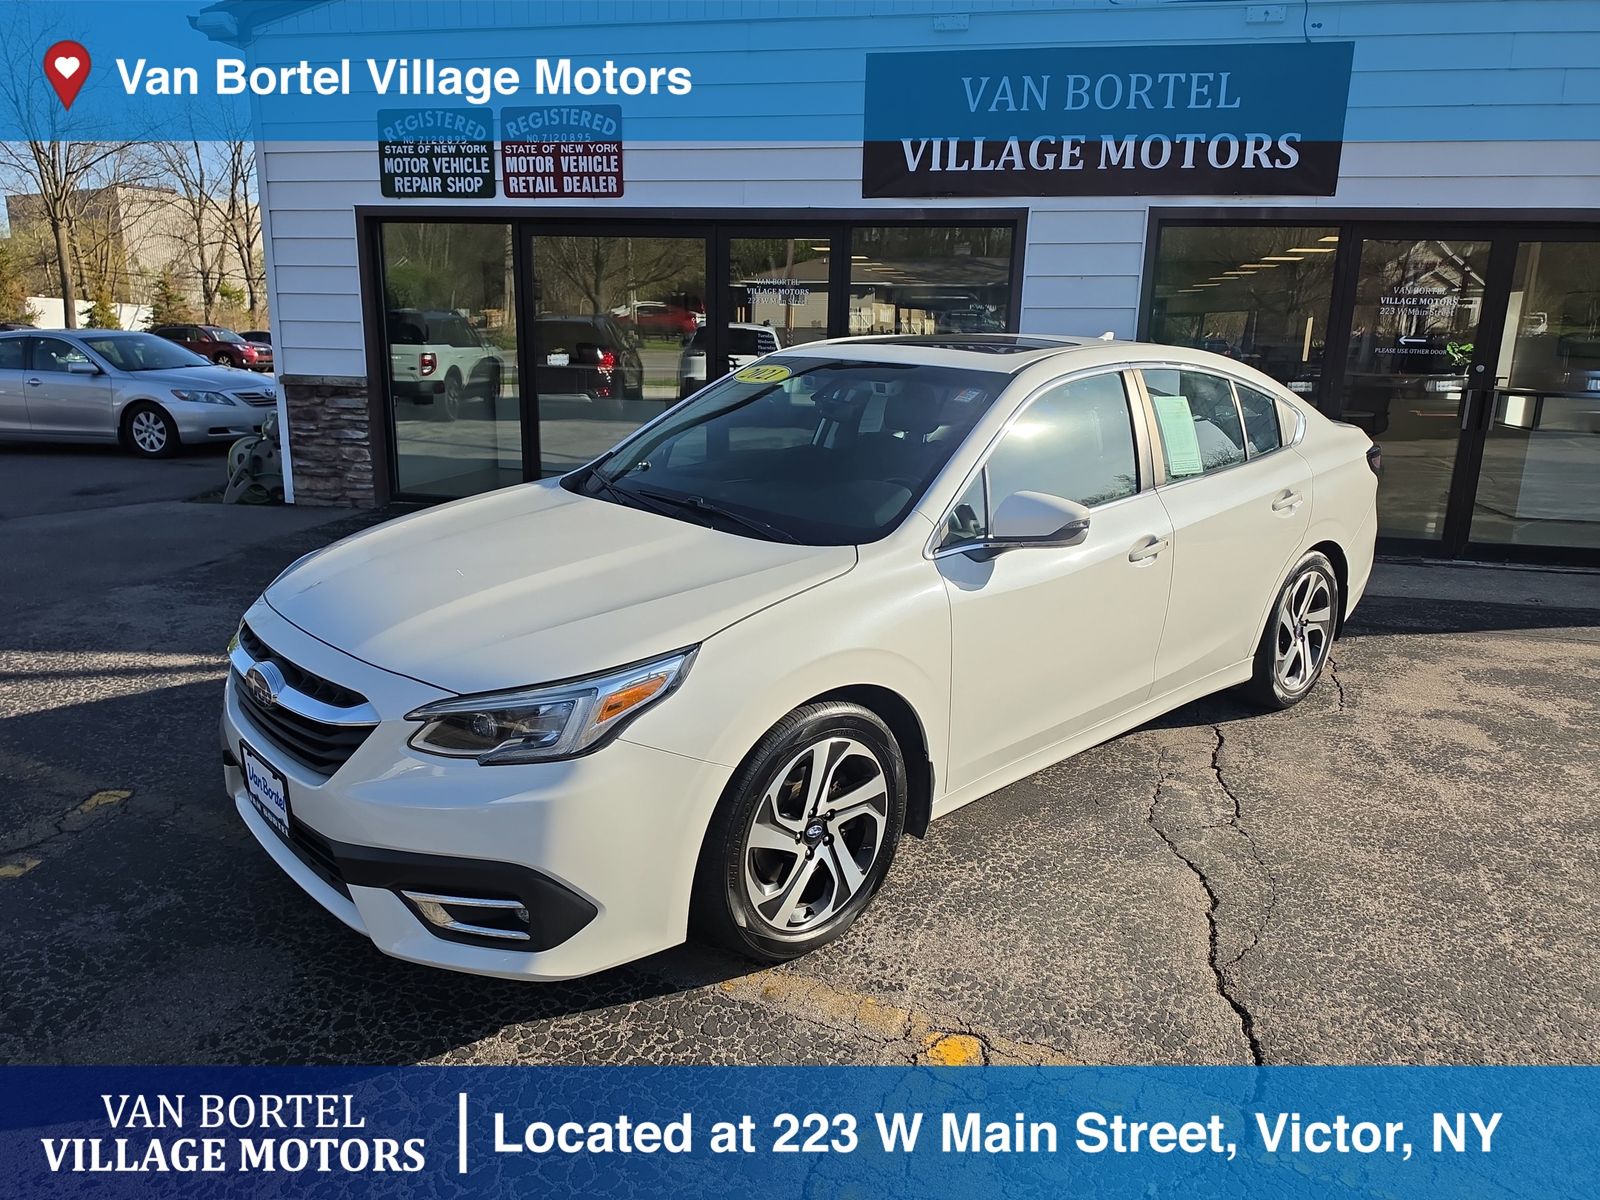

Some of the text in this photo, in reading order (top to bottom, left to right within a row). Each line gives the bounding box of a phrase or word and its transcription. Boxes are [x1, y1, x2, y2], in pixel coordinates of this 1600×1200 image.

[961, 71, 1241, 113] VAN BORTEL
[383, 110, 487, 143] REGISTERED
[505, 107, 617, 139] REGISTERED
[384, 144, 488, 154] STATE OF NEW YORK
[504, 143, 618, 154] STATE OF NEW YORK
[901, 132, 1302, 172] VILLAGE MOTORS
[384, 157, 490, 174] MOTOR VEHICLE
[505, 155, 619, 173] MOTOR VEHICLE
[394, 177, 484, 193] REPAIR SHOP
[509, 176, 618, 193] RETAIL DEALER
[746, 287, 810, 296] VILLAGE MOTORS
[1393, 286, 1412, 295] VAN
[1380, 296, 1459, 306] VILLAGE MOTORS
[1379, 306, 1396, 316] 223
[1397, 307, 1407, 316] W
[1407, 307, 1429, 317] Main
